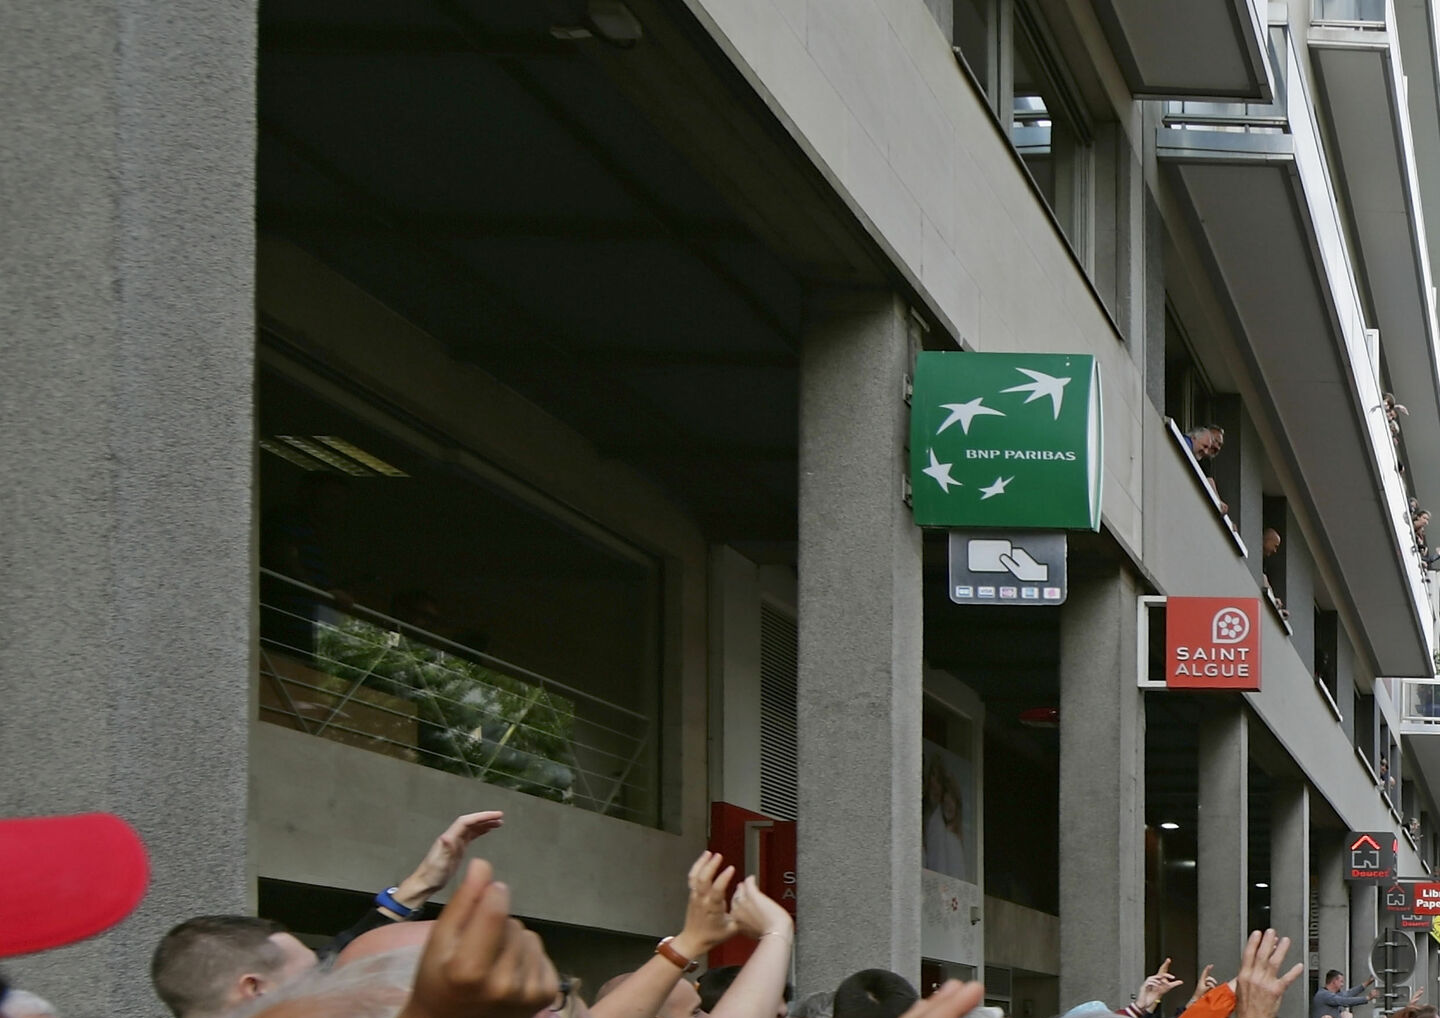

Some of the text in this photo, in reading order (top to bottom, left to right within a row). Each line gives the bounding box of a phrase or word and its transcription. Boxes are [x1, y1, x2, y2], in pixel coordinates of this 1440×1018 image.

[965, 448, 1077, 461] BNP PARIBAS
[1176, 646, 1250, 661] SAINT
[1175, 663, 1250, 677] ALGUE
